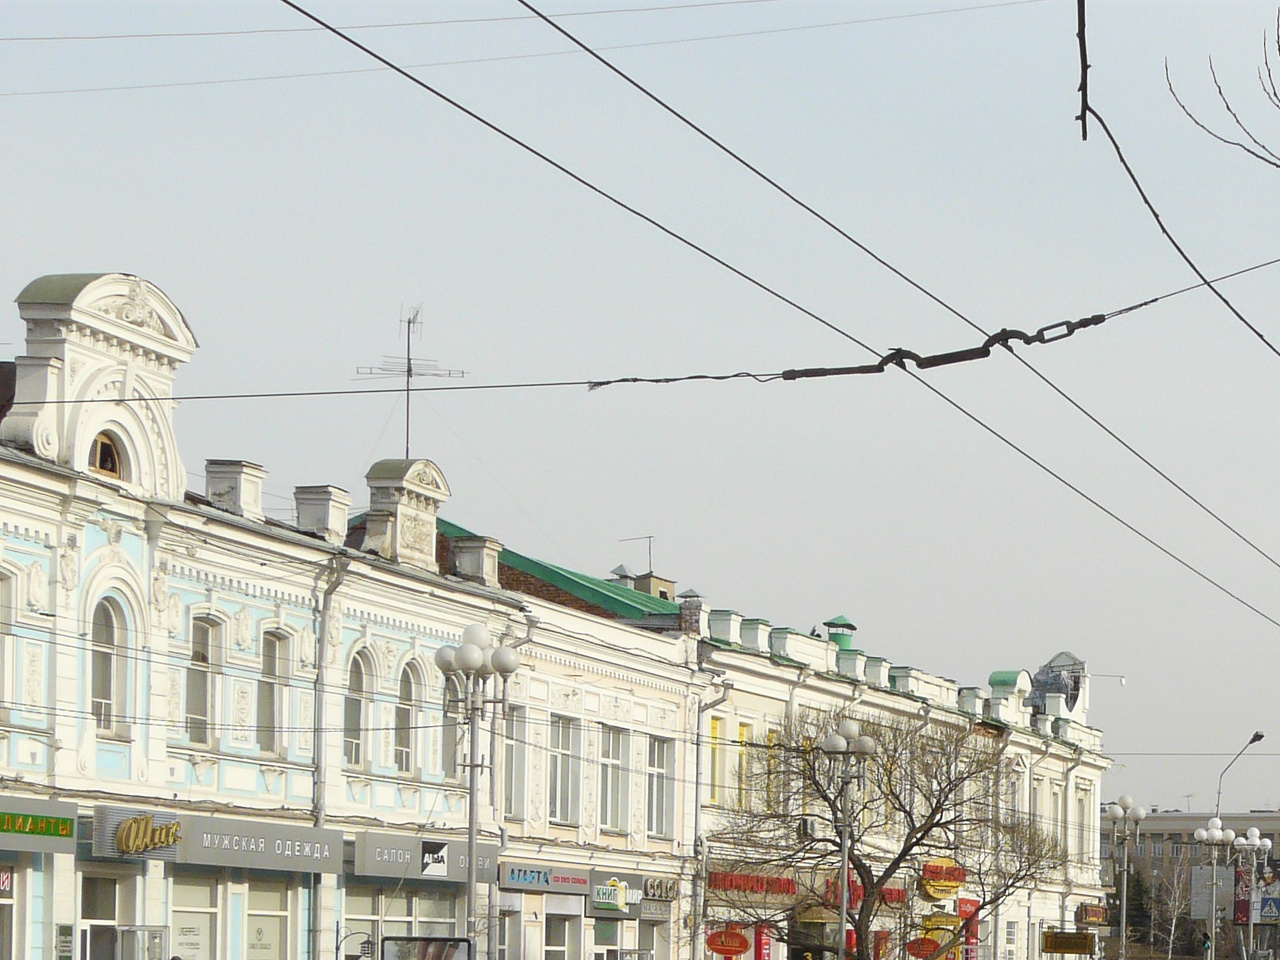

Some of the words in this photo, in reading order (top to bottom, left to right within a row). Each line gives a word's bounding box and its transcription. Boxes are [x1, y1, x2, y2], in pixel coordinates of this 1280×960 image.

[0, 813, 72, 837] ЛИАНТЫ
[202, 832, 266, 853] МУЖСКАЯ
[274, 839, 331, 860] ОДЕЖДА
[375, 848, 412, 863] САЛОН
[459, 855, 491, 870] ОВИ
[508, 868, 551, 887] АГАРТА
